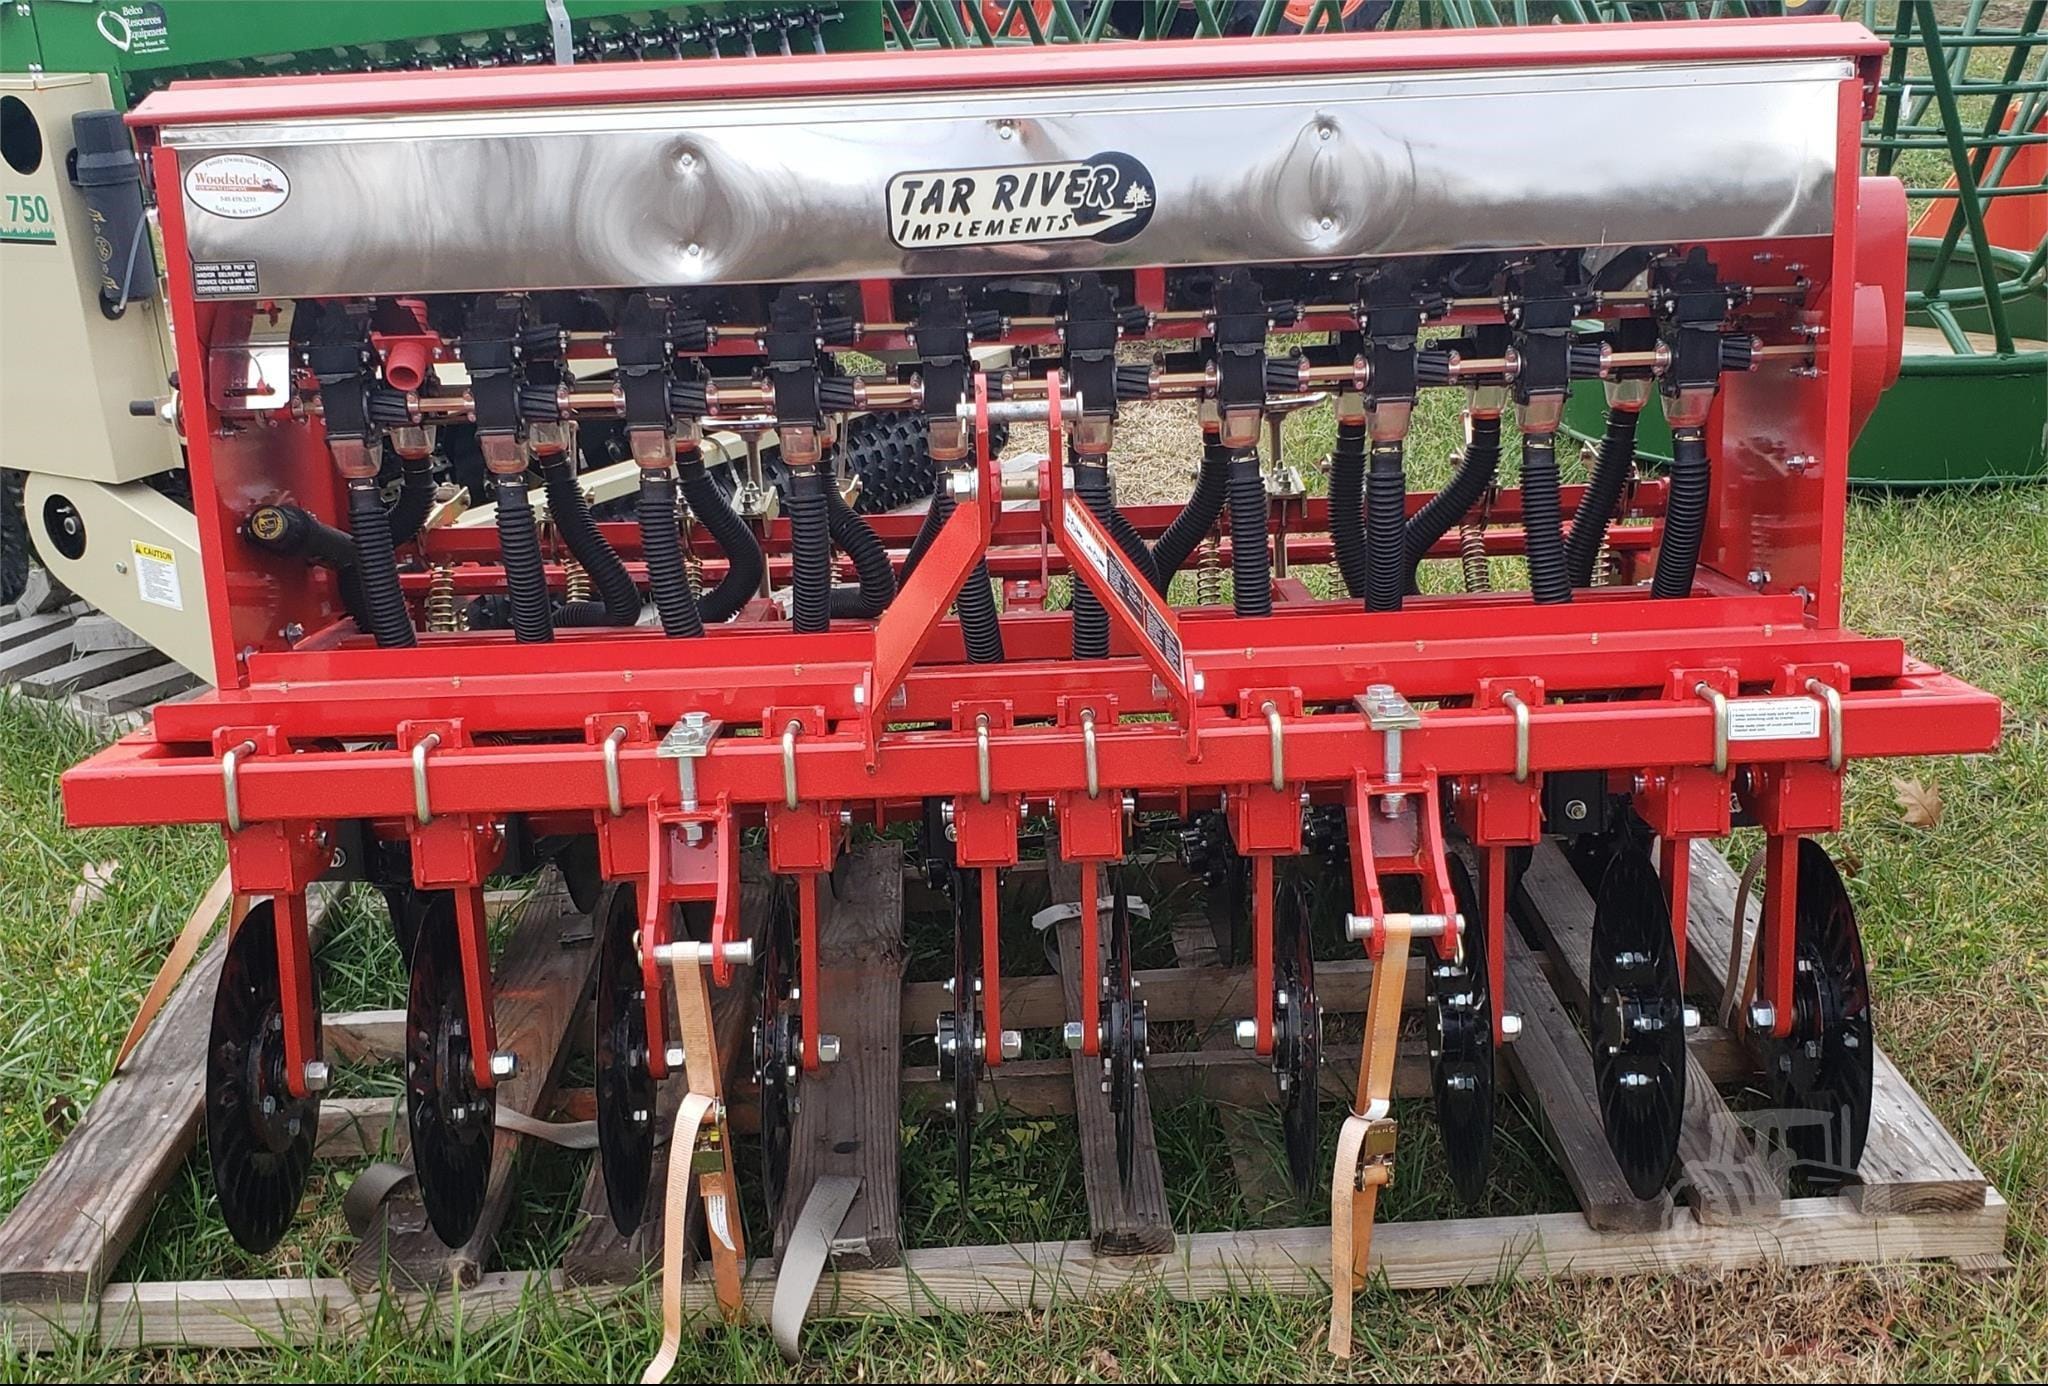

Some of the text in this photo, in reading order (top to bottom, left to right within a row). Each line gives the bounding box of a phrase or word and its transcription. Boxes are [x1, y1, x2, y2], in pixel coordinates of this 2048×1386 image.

[122, 5, 143, 16] Belco
[195, 172, 260, 185] Woodstock
[900, 164, 1118, 216] TAR RIVER
[6, 195, 49, 223] 750
[216, 205, 230, 213] Sales
[144, 547, 172, 560] CAUTION
